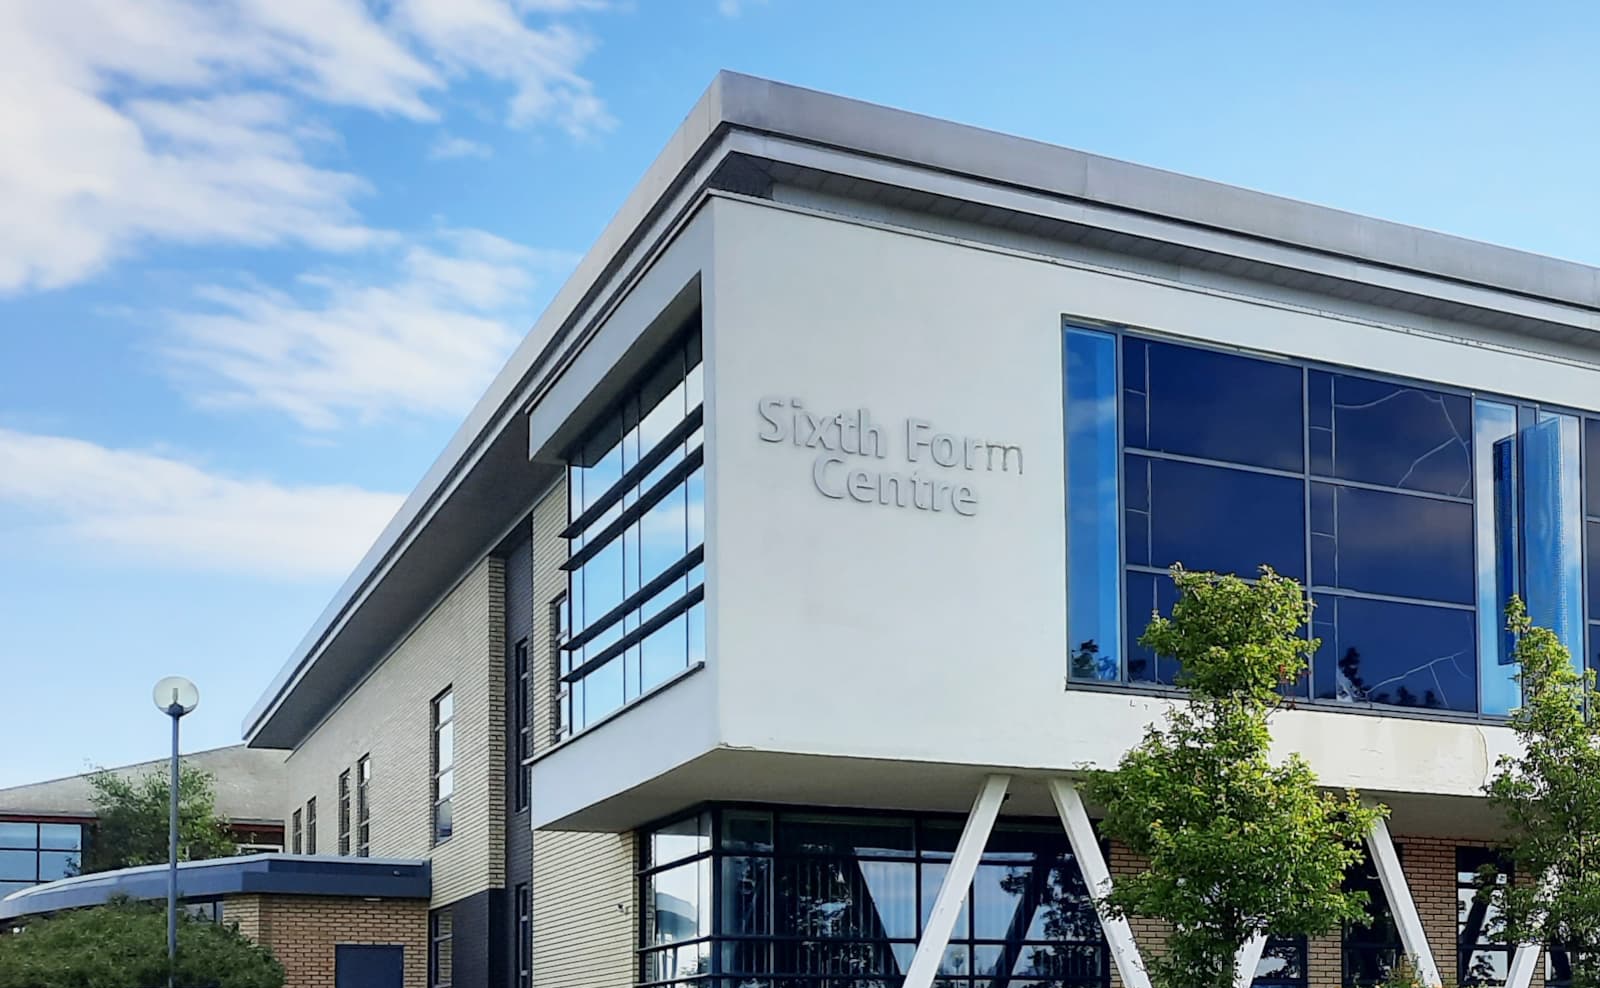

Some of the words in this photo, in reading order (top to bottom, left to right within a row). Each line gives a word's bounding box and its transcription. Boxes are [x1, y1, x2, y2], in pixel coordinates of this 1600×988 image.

[758, 397, 886, 459] Sixth
[906, 417, 1024, 475] Form
[812, 454, 979, 517] Centre
